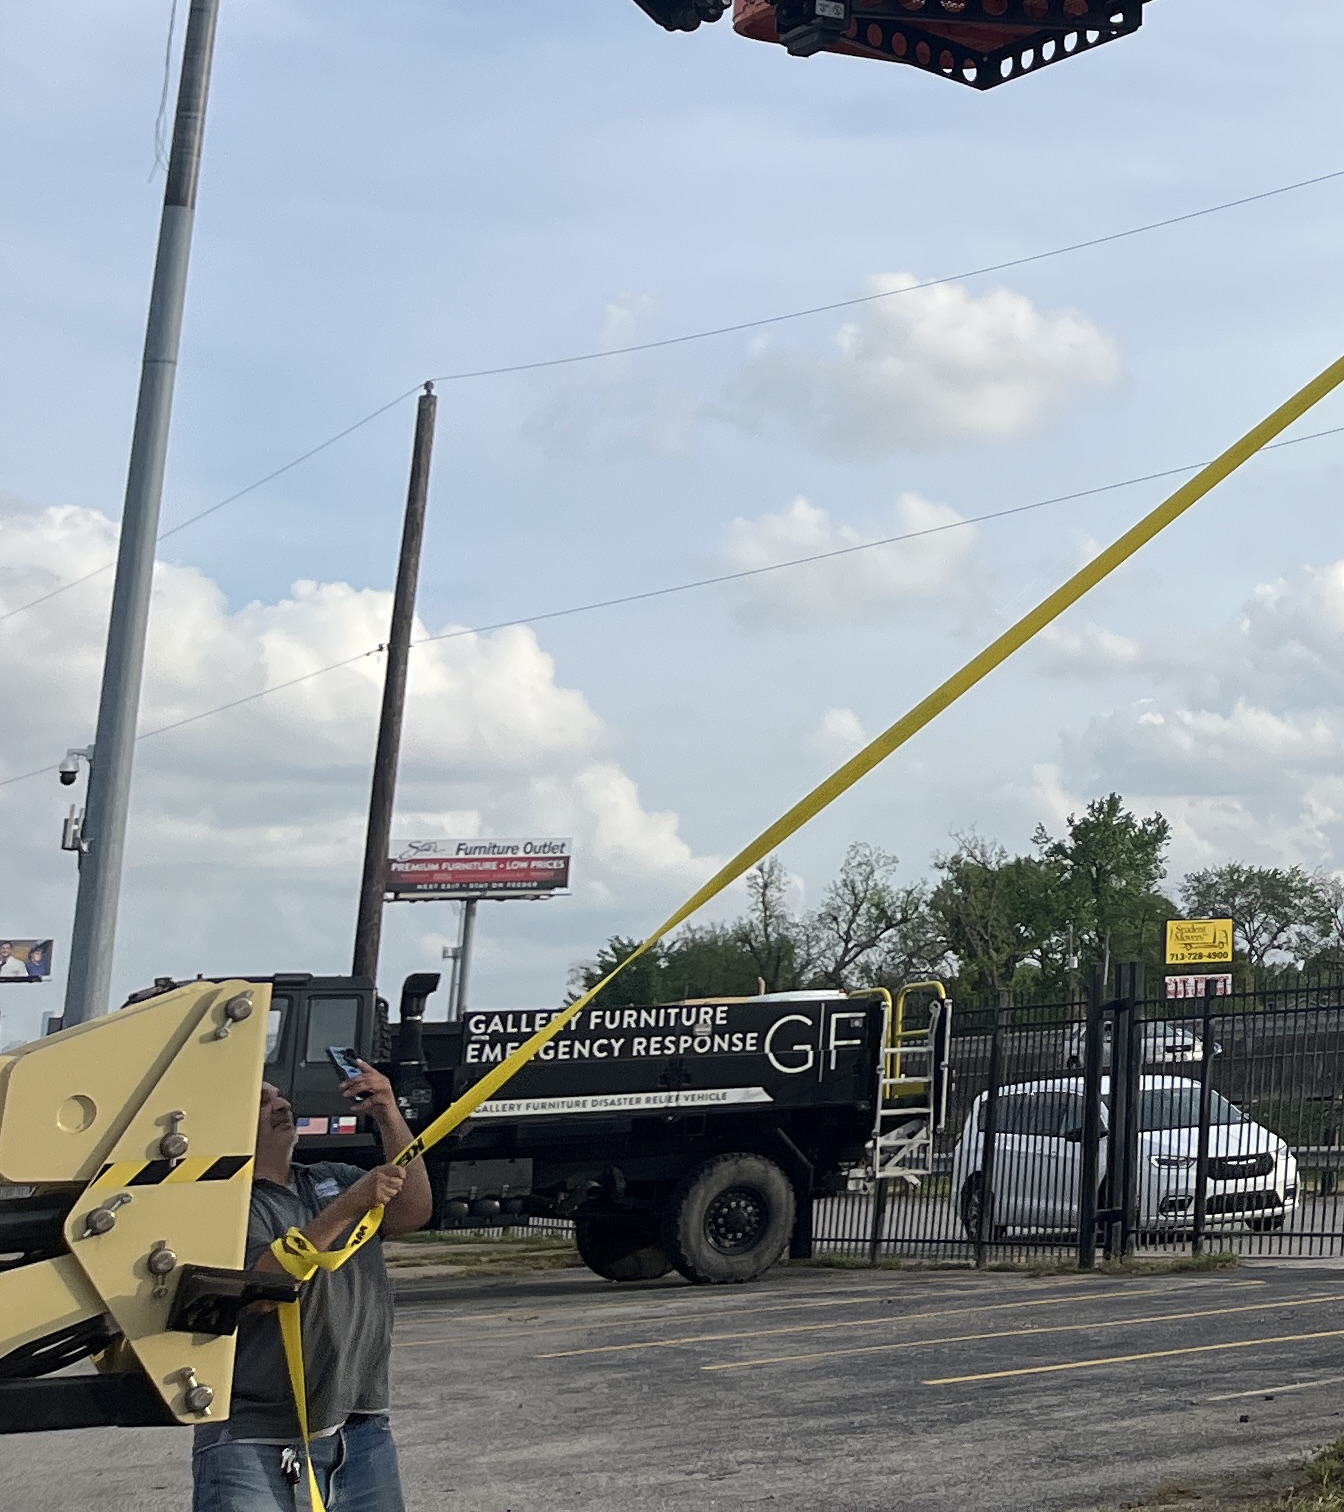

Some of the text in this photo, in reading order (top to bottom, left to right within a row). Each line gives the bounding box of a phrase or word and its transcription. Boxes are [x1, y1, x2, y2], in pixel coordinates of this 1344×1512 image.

[455, 841, 519, 856] Furniture
[523, 841, 566, 855] Outlet
[441, 861, 498, 871] FURNITURE
[506, 860, 529, 870] LOW
[530, 859, 565, 870] PRICES
[1170, 951, 1229, 961] 713-728-4900
[469, 1006, 729, 1034] GALLEY FURNITURE
[466, 1032, 759, 1063] EMEGENCY RESPONSE
[474, 1092, 727, 1113] GALLERY FURNITURE DISASTER RELIEF VEHICLE
